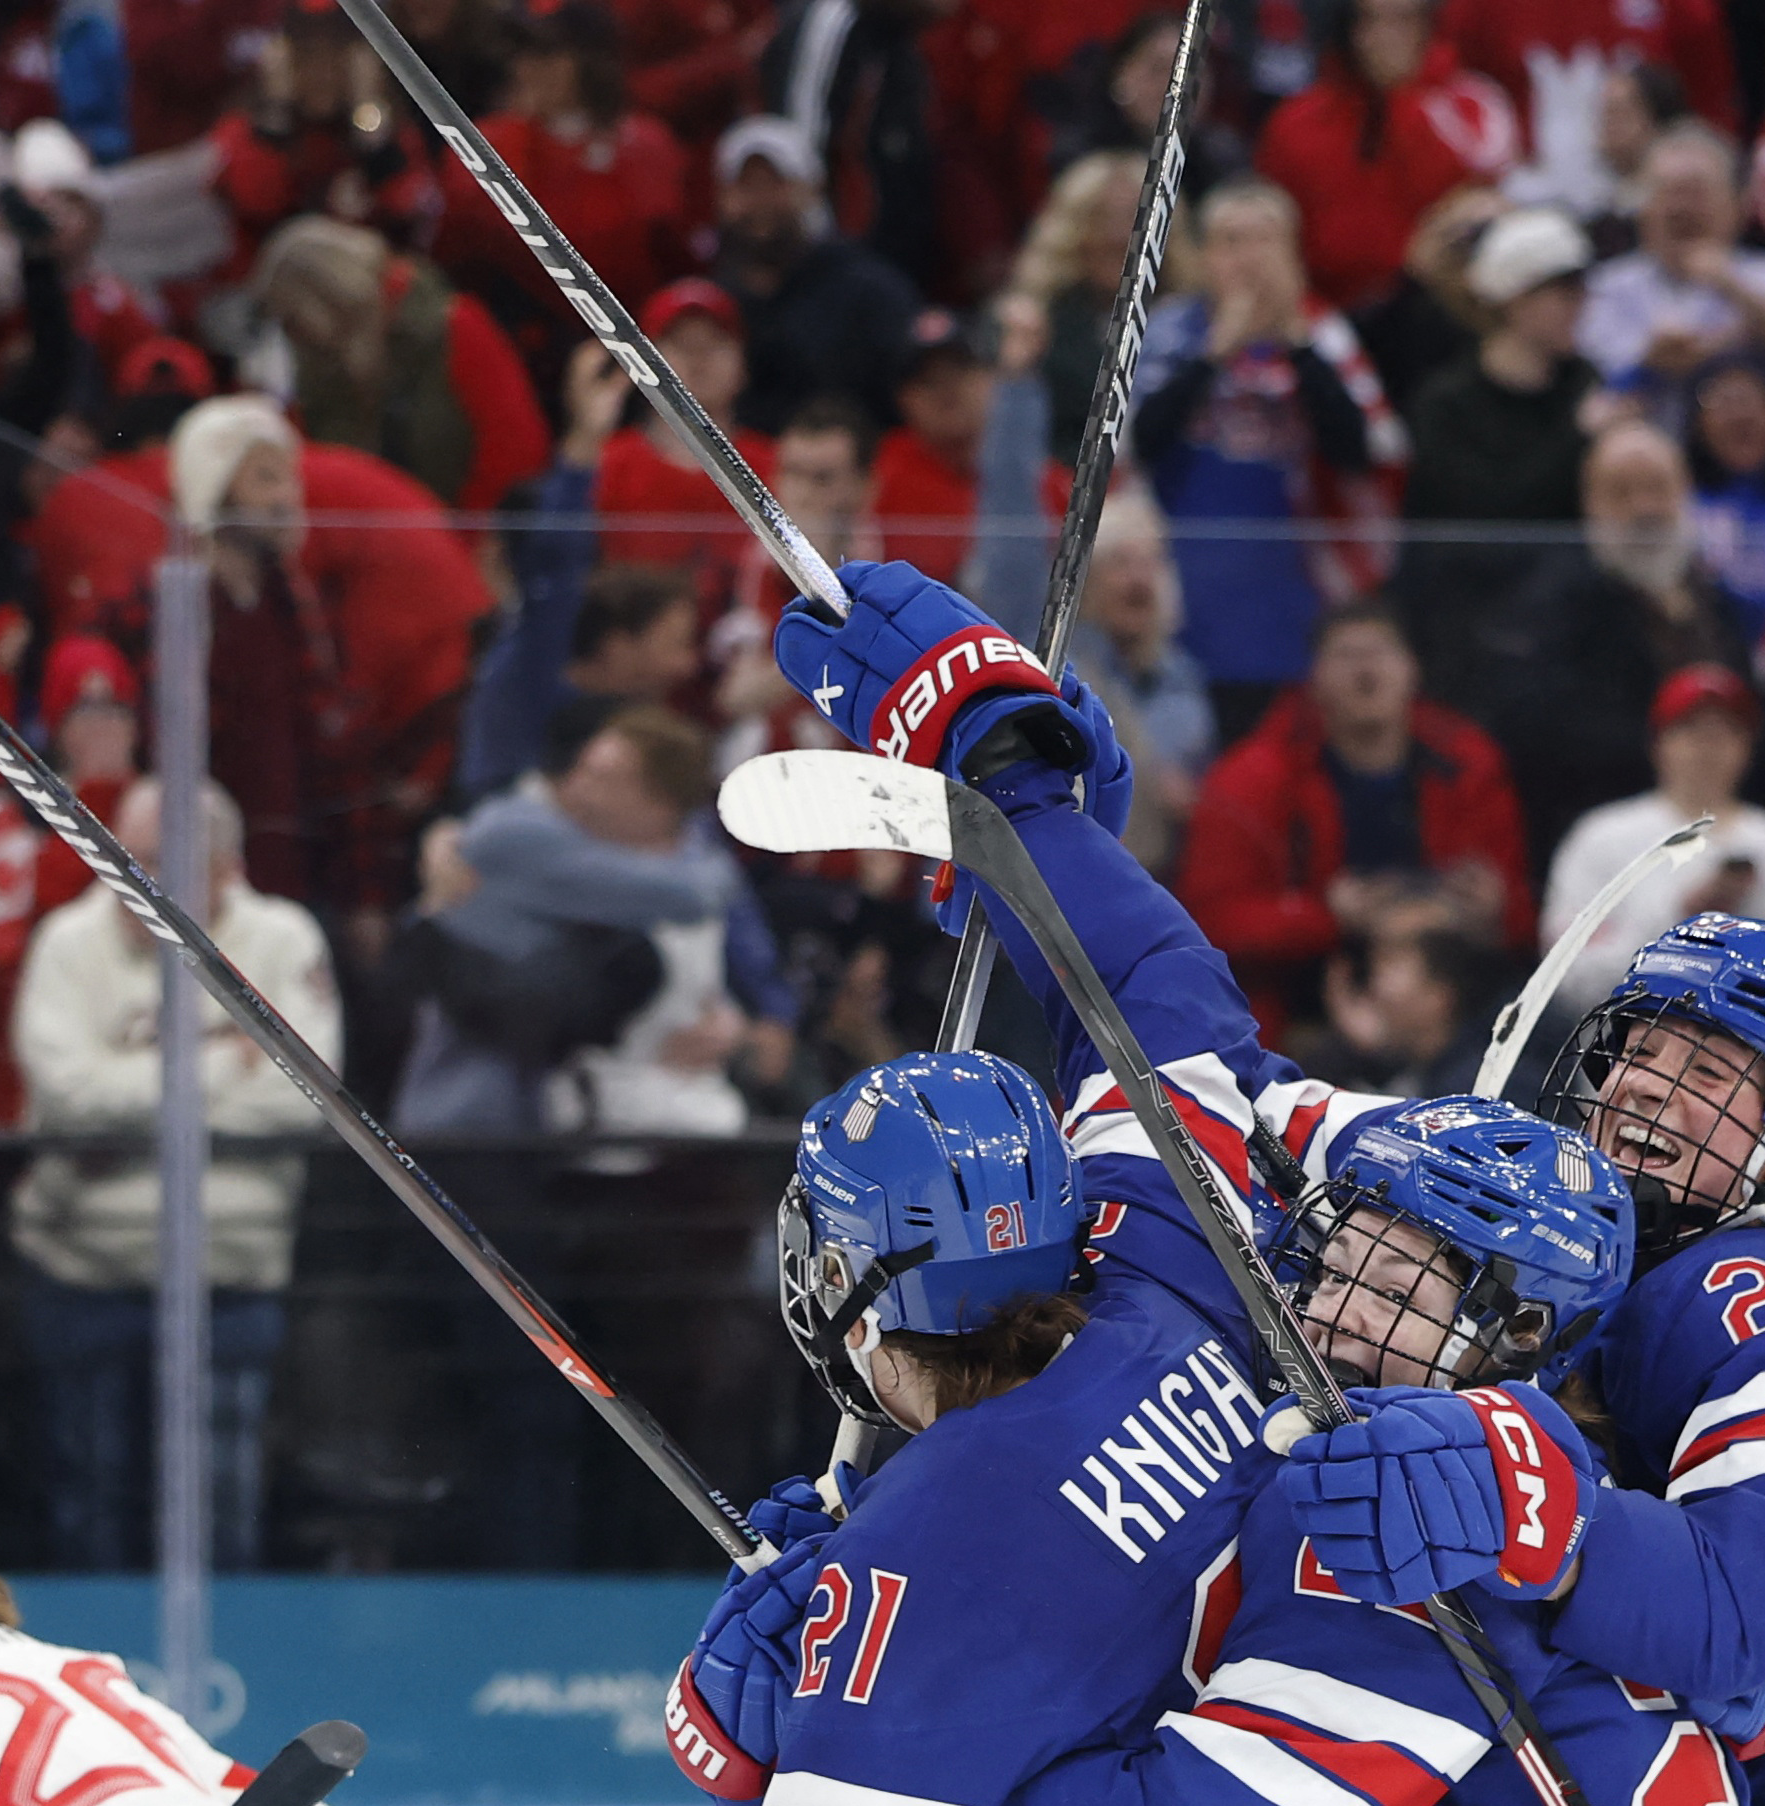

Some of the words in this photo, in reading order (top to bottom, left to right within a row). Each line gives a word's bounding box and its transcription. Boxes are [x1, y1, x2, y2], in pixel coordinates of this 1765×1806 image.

[435, 122, 660, 388] BAUER
[1561, 1141, 1584, 1159] USA
[813, 1174, 857, 1206] BAUER
[985, 1201, 1028, 1252] 21
[1530, 1223, 1596, 1265] BAUER
[1058, 1339, 1267, 1564] KNIGH
[1455, 1385, 1549, 1549] CCM
[1564, 1514, 1586, 1555] HEISE
[792, 1562, 908, 1705] 21
